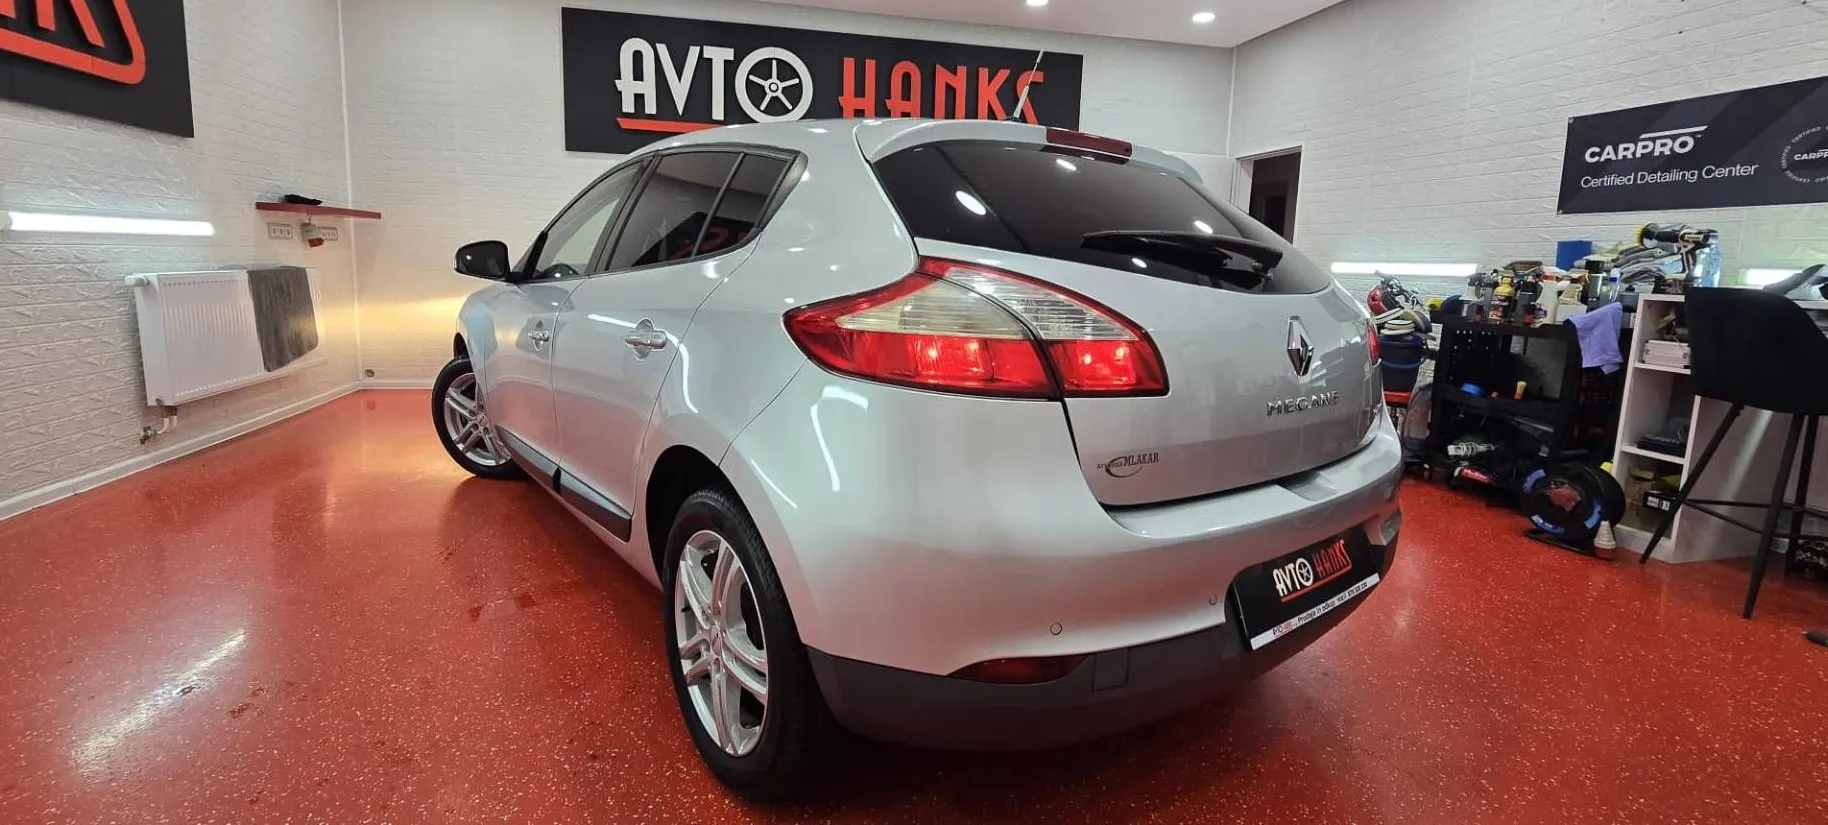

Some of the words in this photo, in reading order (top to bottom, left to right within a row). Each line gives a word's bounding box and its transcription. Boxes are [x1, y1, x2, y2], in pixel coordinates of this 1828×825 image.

[614, 37, 813, 122] AVTO
[838, 57, 1044, 121] HANKS
[1584, 135, 1695, 163] CARPRO
[1793, 151, 1828, 160] CARPR
[1581, 173, 1633, 188] Certified
[1637, 168, 1698, 184] Detailing
[1701, 163, 1759, 179] Center
[1266, 391, 1339, 417] MEGANE
[1123, 452, 1159, 466] MLAKAR
[1272, 557, 1313, 597] AVTO
